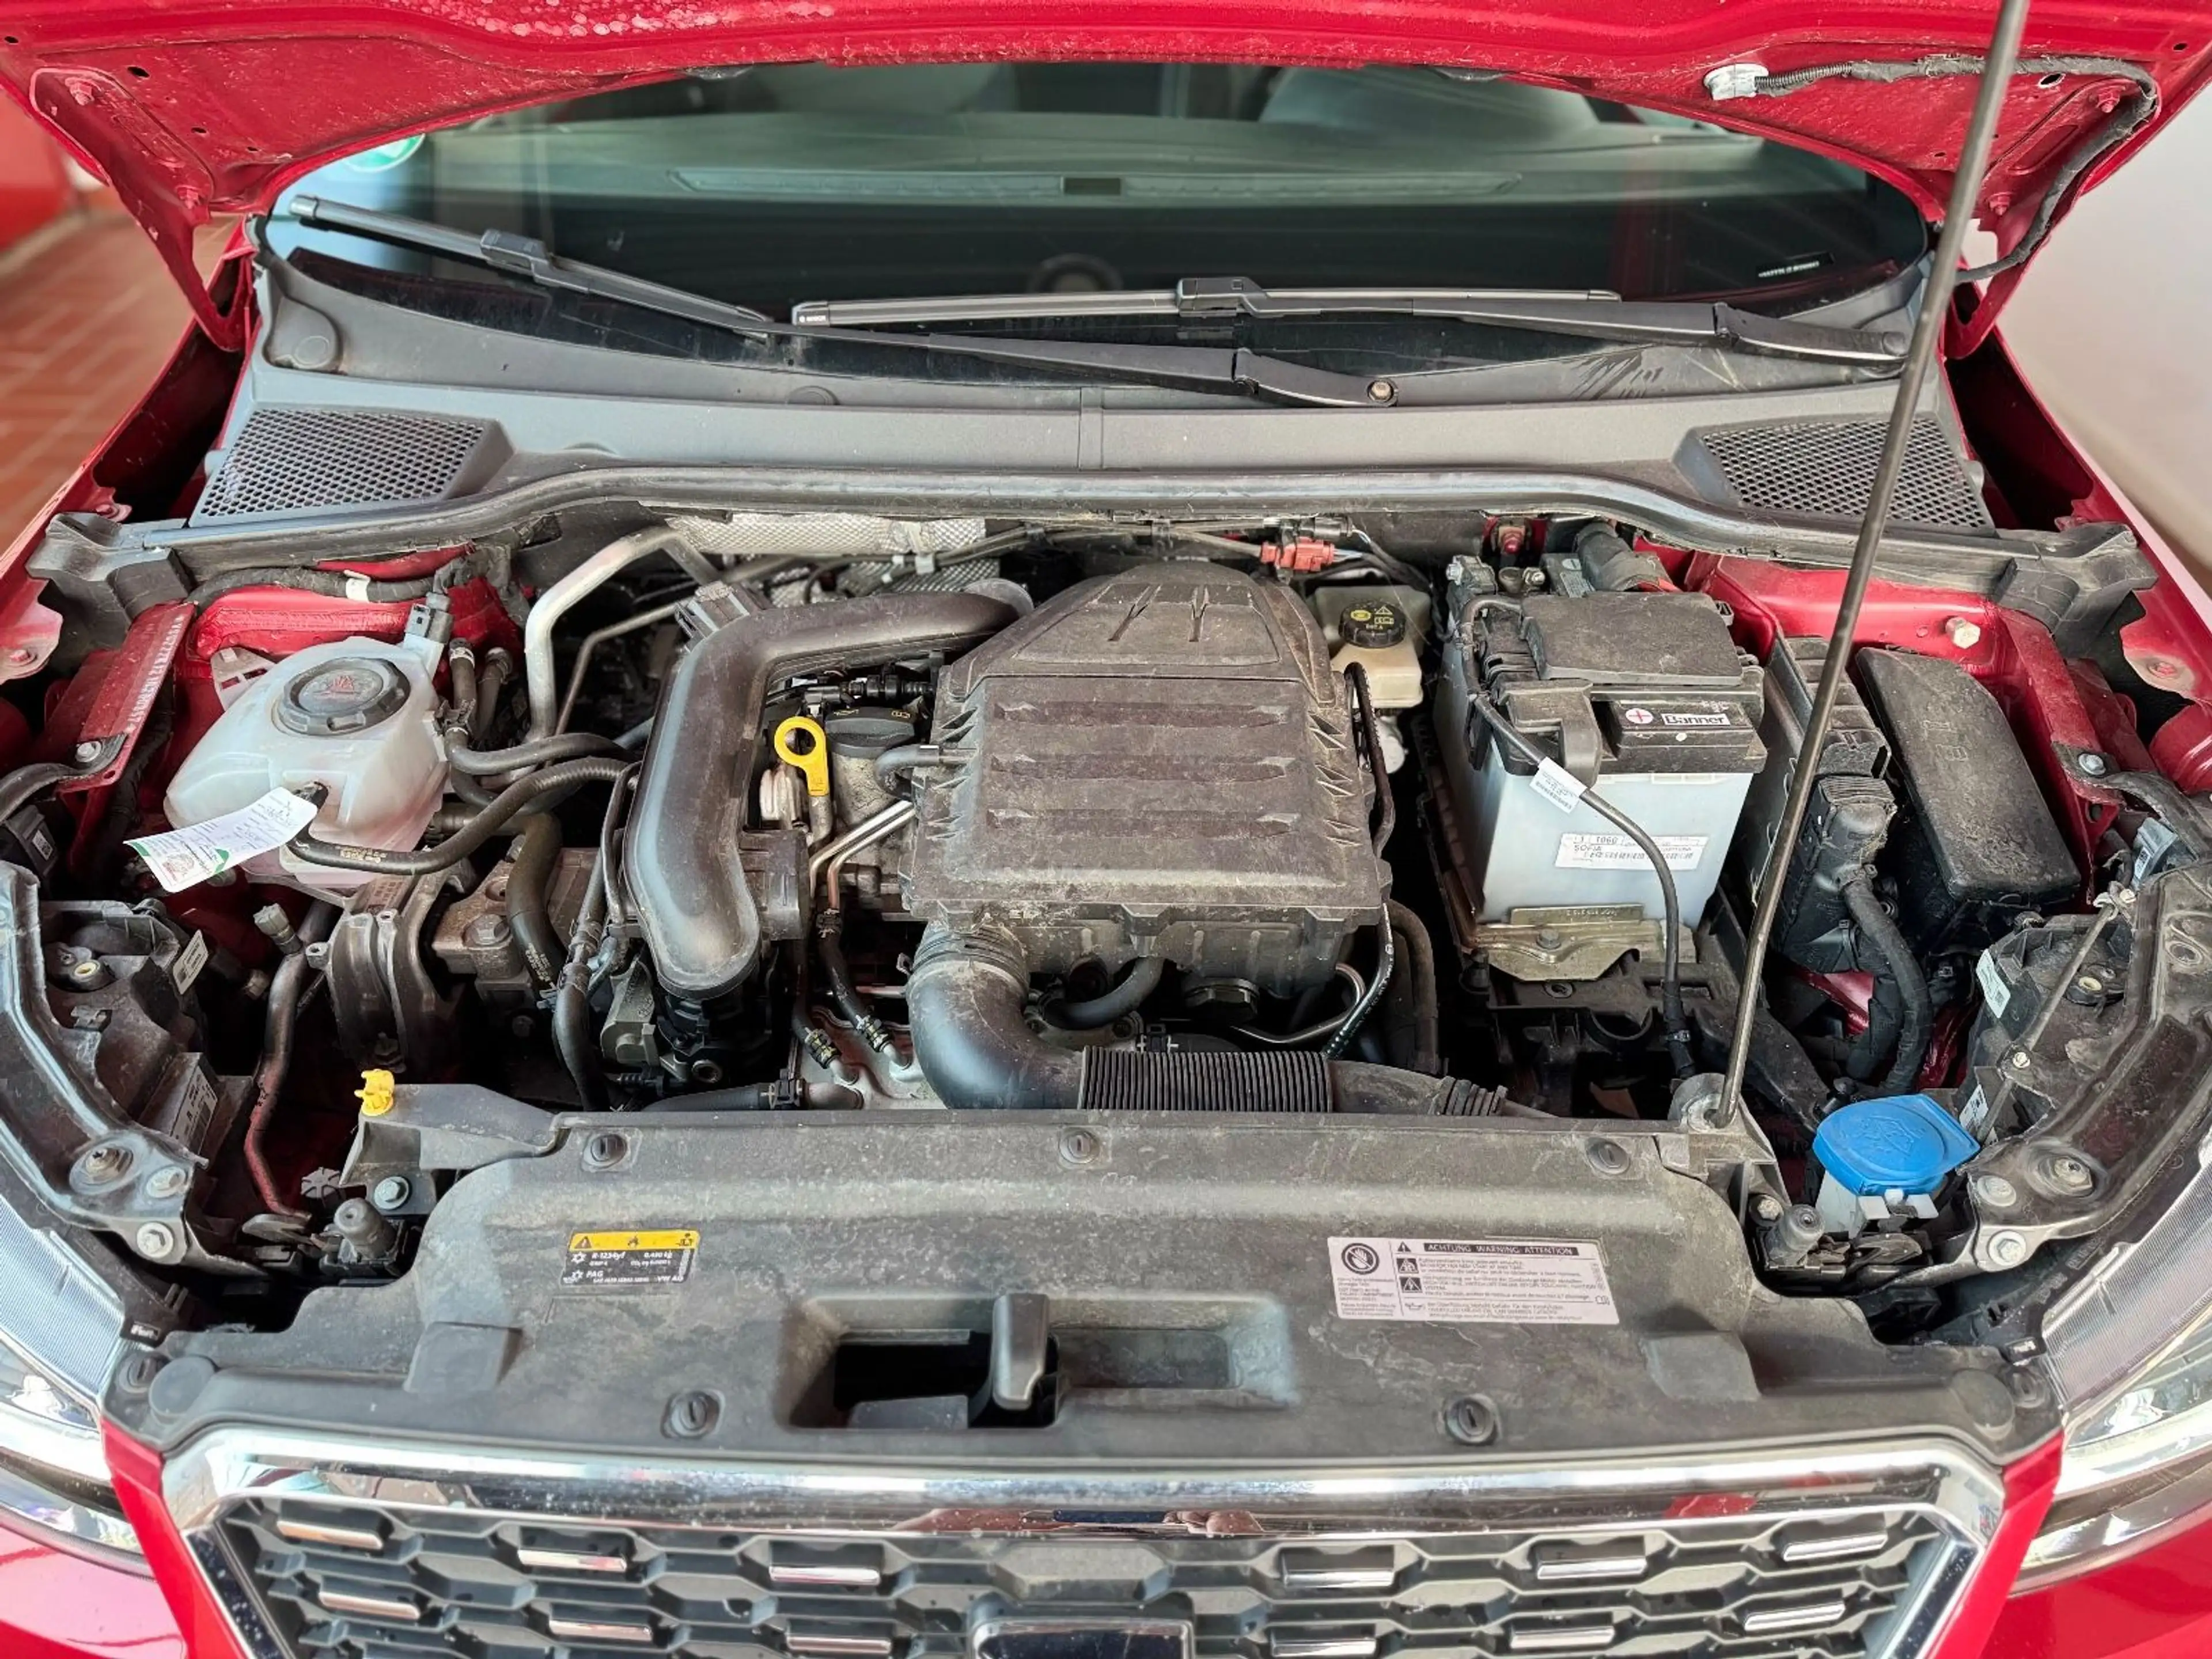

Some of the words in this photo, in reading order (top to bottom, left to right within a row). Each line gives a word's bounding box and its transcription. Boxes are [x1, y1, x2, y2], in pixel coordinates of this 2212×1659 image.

[1665, 714, 1724, 724] Banner
[1428, 1244, 1471, 1252] ACHTUNG
[1475, 1245, 1521, 1254] WARNING
[1524, 1247, 1573, 1255] ATTENTION
[586, 1270, 604, 1278] PAG
